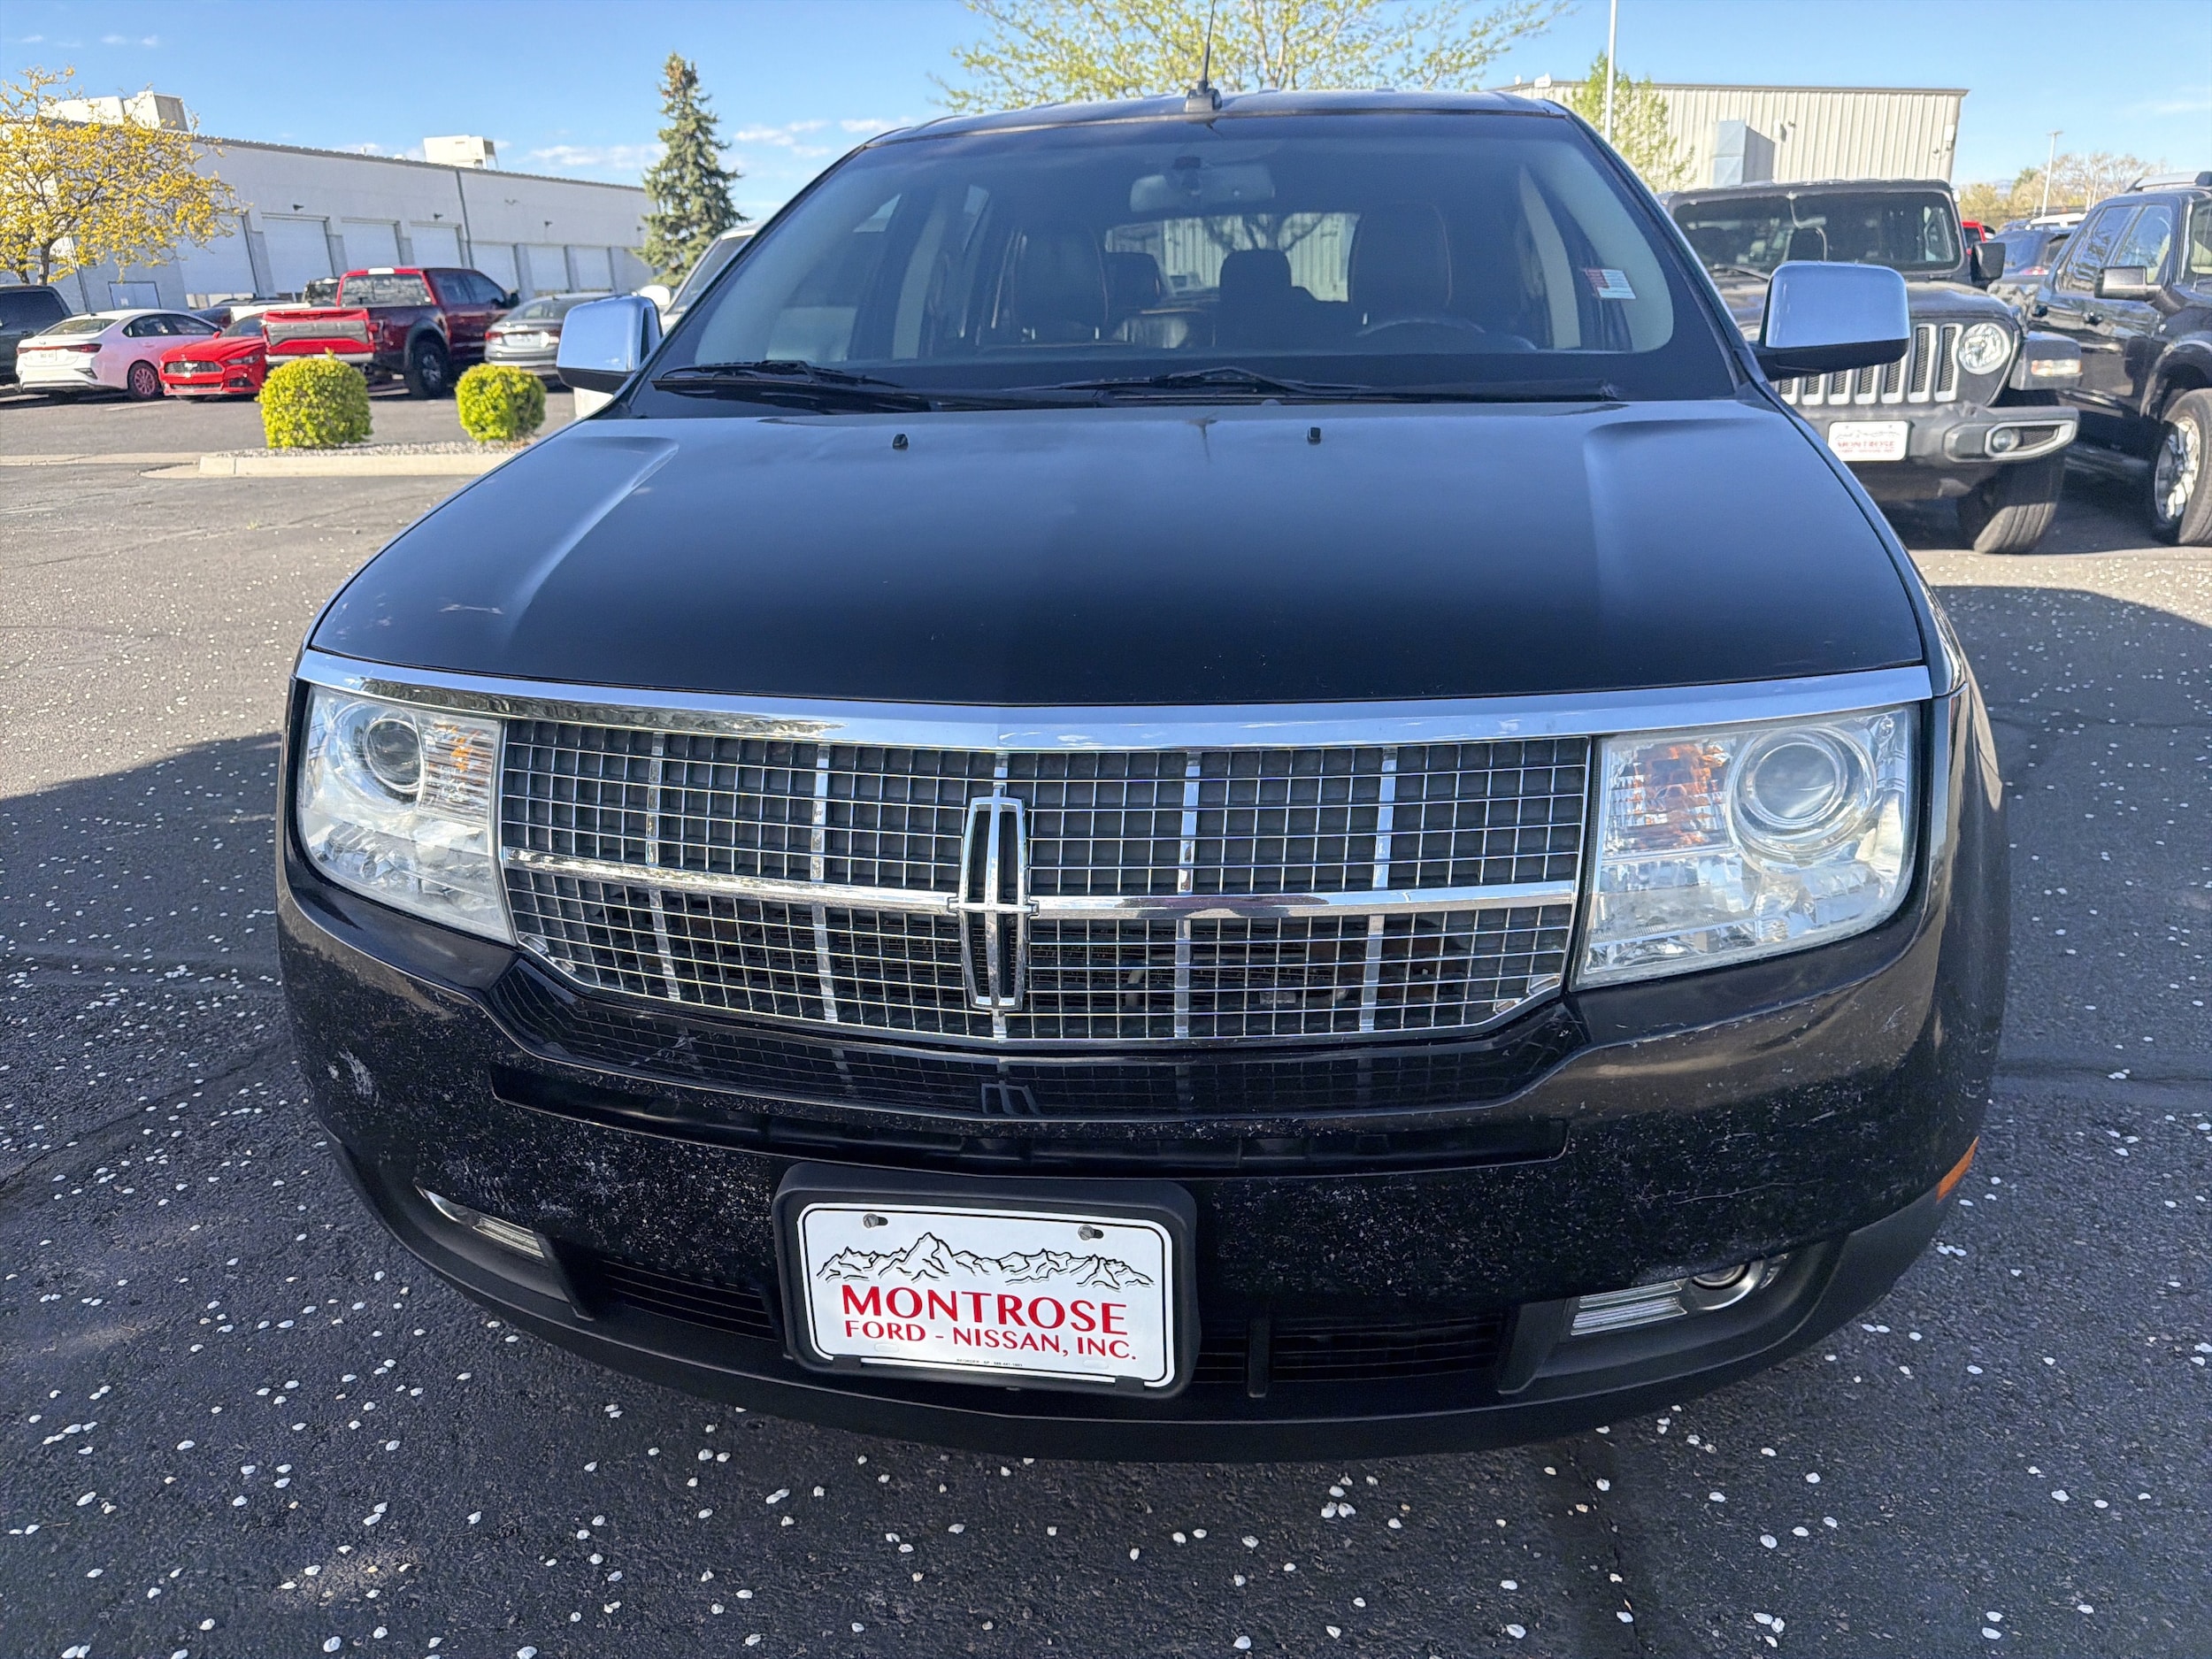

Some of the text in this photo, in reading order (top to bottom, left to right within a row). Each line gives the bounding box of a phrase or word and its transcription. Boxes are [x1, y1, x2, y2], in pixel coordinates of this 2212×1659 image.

[841, 1284, 1127, 1336] MONTROSE
[844, 1319, 926, 1342] FORD
[952, 1327, 1069, 1356] NISSAN,
[1077, 1337, 1137, 1360] INC.
